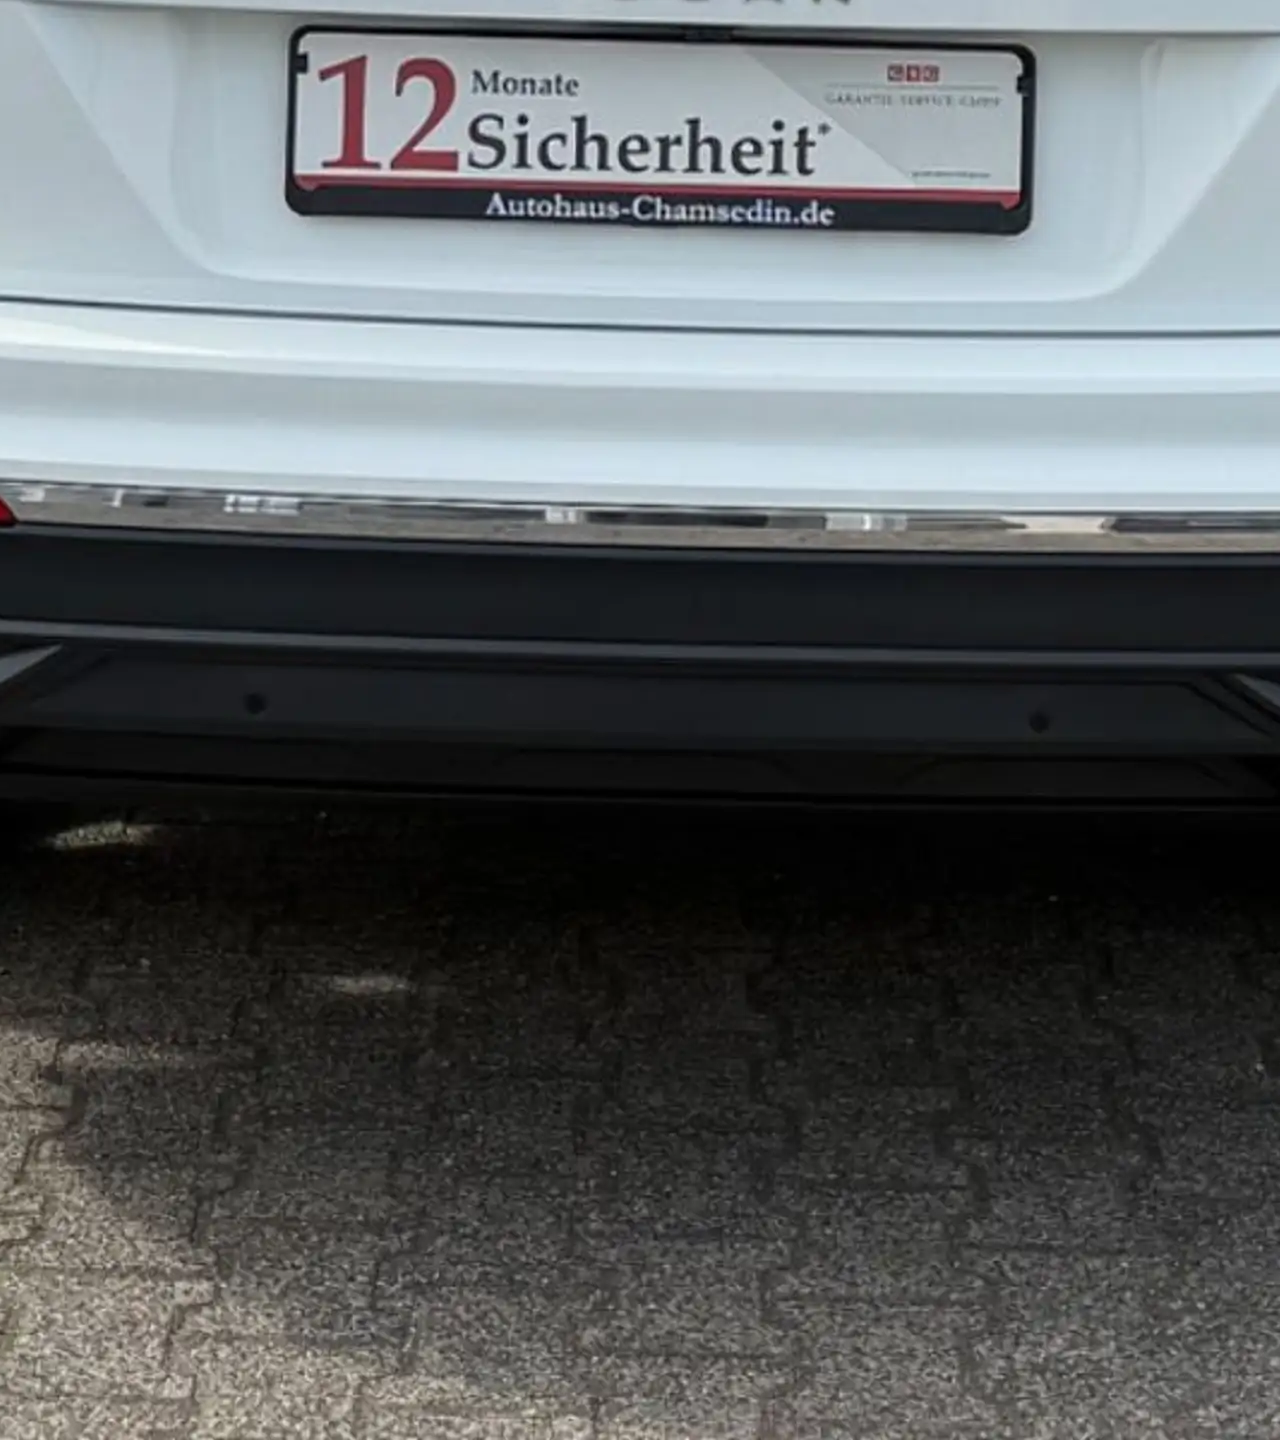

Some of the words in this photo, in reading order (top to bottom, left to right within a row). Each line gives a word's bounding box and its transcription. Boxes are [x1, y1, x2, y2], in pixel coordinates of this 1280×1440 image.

[471, 69, 580, 97] Monate
[317, 54, 460, 172] 12
[485, 191, 836, 226] Autohaus-Chamsedin.de
